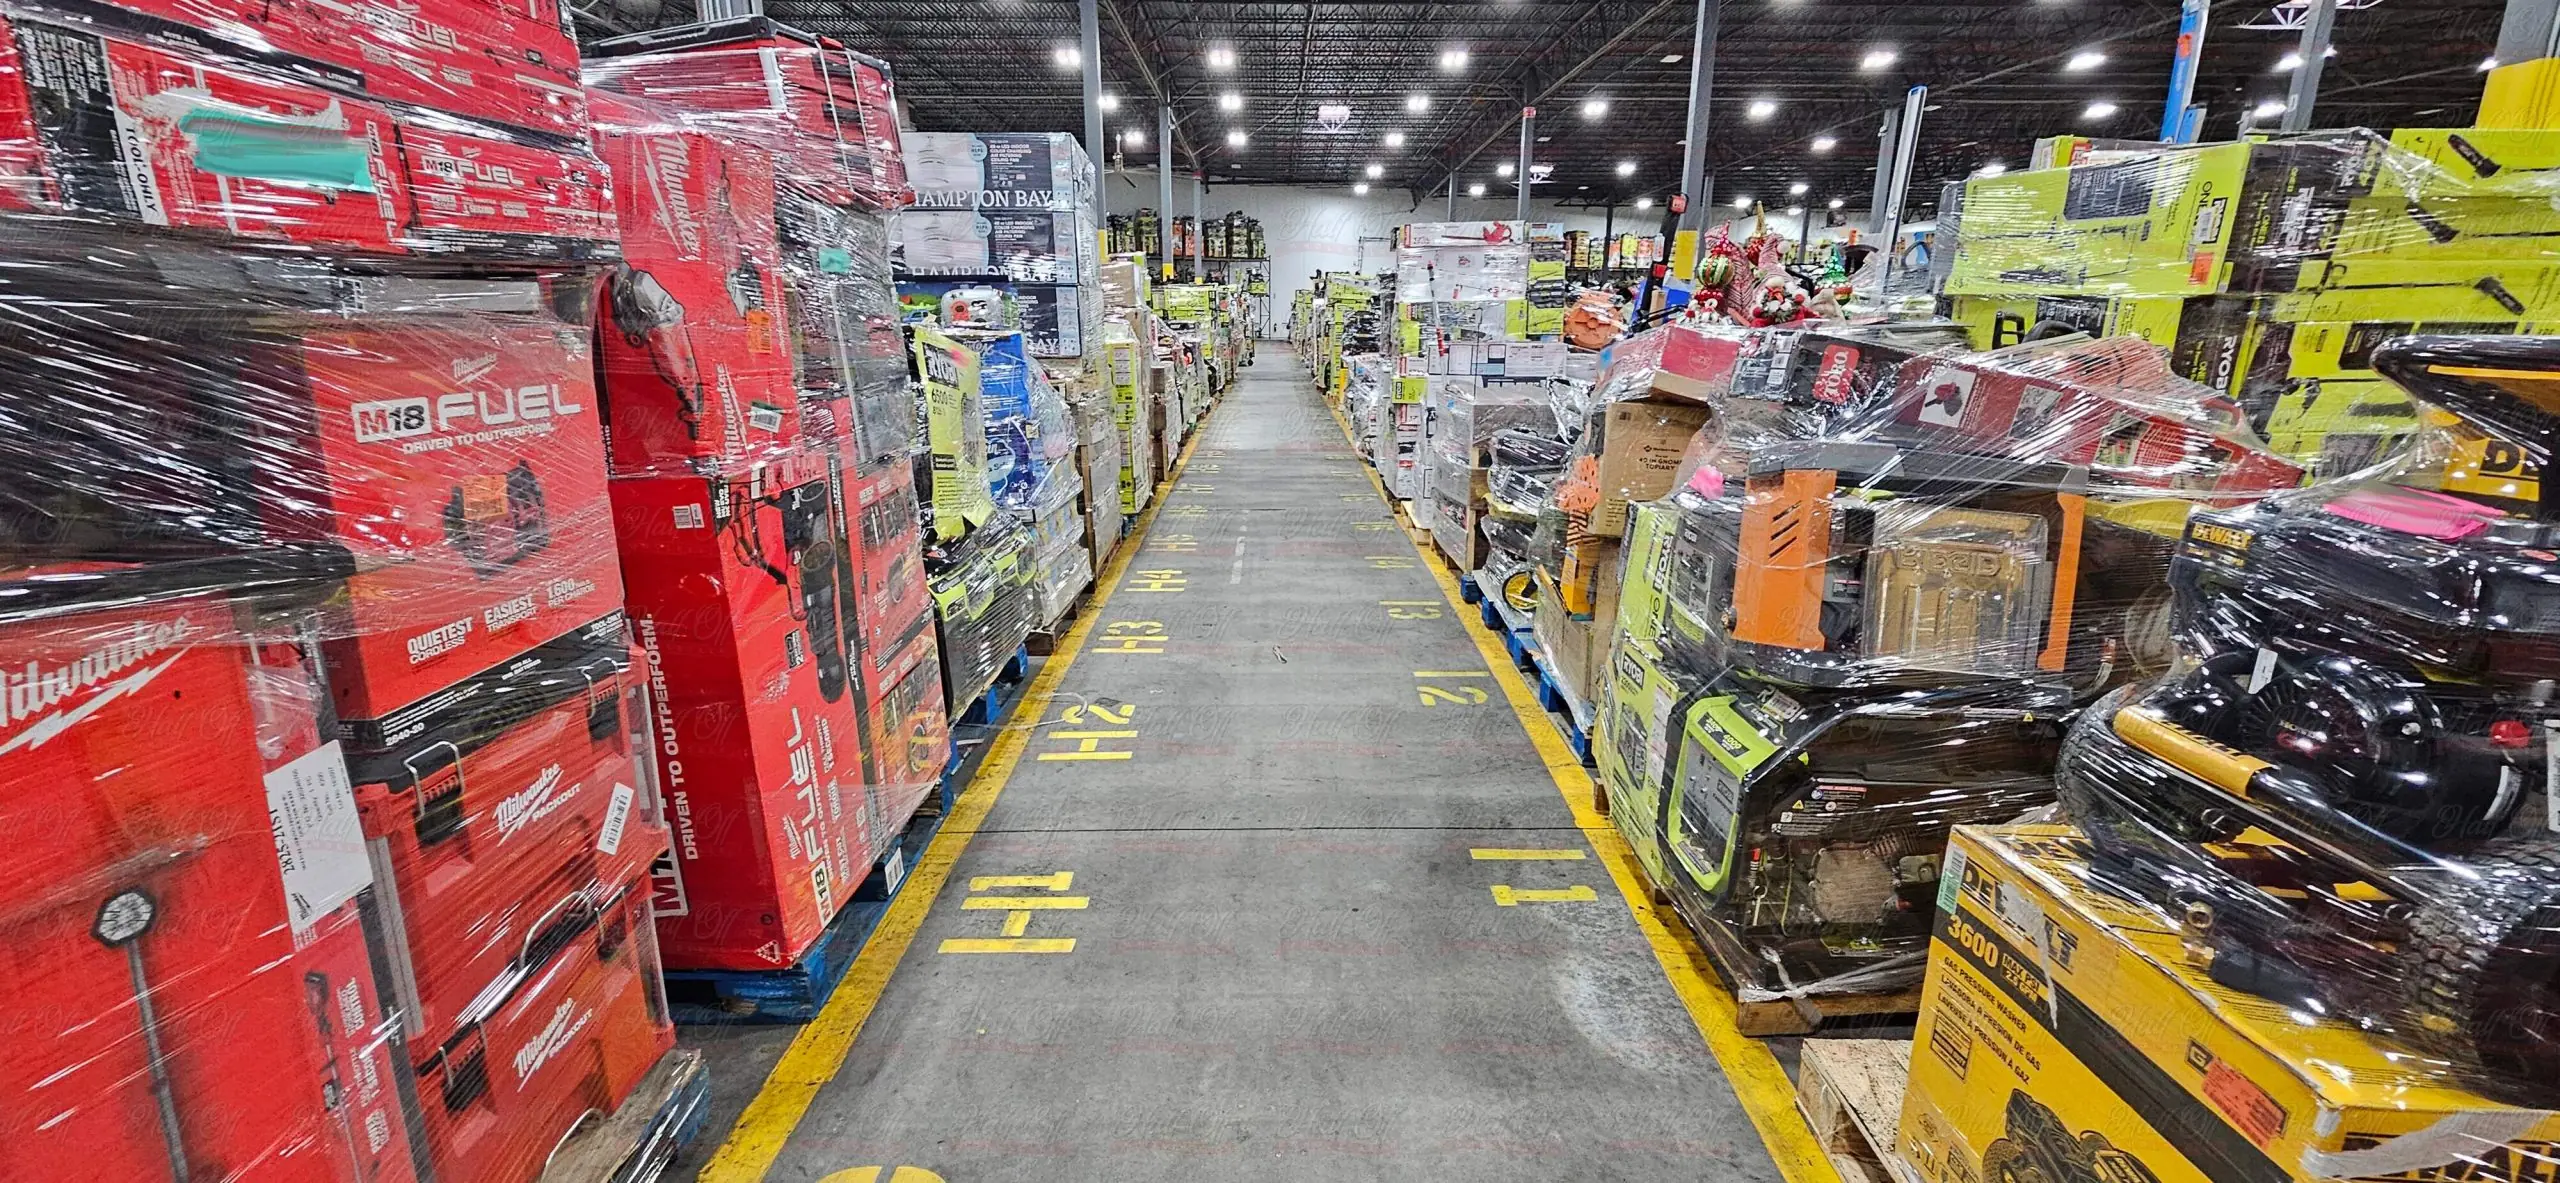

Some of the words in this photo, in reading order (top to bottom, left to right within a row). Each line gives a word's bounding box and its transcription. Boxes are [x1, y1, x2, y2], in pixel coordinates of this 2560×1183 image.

[424, 157, 455, 175] M18
[457, 159, 525, 185] FUEL
[652, 133, 702, 257] Milwaukee
[1015, 190, 1052, 208] BAY
[452, 352, 498, 379] Milwaukee
[358, 404, 426, 436] M18
[437, 384, 582, 431] FUEL
[404, 437, 453, 454] DRIVEN
[457, 434, 473, 446] TO
[1645, 462, 1676, 471] TOPIARY
[1655, 535, 1674, 594] RYOBI
[484, 594, 536, 622] EASIEST
[487, 607, 539, 633] TRANSPORT
[407, 616, 473, 655] QUIETEST
[409, 639, 465, 665] CORDLESS
[1092, 621, 1170, 654] H3
[643, 614, 679, 757] OUTPERFORM.
[1623, 656, 1644, 688] RYOBI
[385, 722, 425, 747] 2840-20
[1037, 704, 1138, 761] H2
[492, 763, 562, 833] Milwaukee
[668, 761, 685, 787] TO
[787, 708, 824, 863] FUEL
[532, 783, 581, 823] PACKOUT
[674, 791, 698, 860] DRIVEN
[814, 867, 833, 923] M18
[938, 872, 1090, 955] H1
[1947, 914, 1999, 969] 3600
[2003, 954, 2024, 978] MAX
[2025, 972, 2040, 993] PSI
[1944, 957, 1959, 973] GAS
[1959, 968, 1996, 1006] PRESSURE
[1996, 1000, 2028, 1034] WASHER
[512, 998, 575, 1082] Milwaukee
[549, 1008, 593, 1058] PACKOUT
[1937, 991, 1968, 1025] LAVEUSE
[1973, 1025, 2008, 1064] PRESSION
[2014, 1066, 2031, 1086] GAZ
[1941, 974, 1976, 1010] LAVADORA
[2014, 1041, 2024, 1055] DE
[2024, 1051, 2042, 1072] GAS
